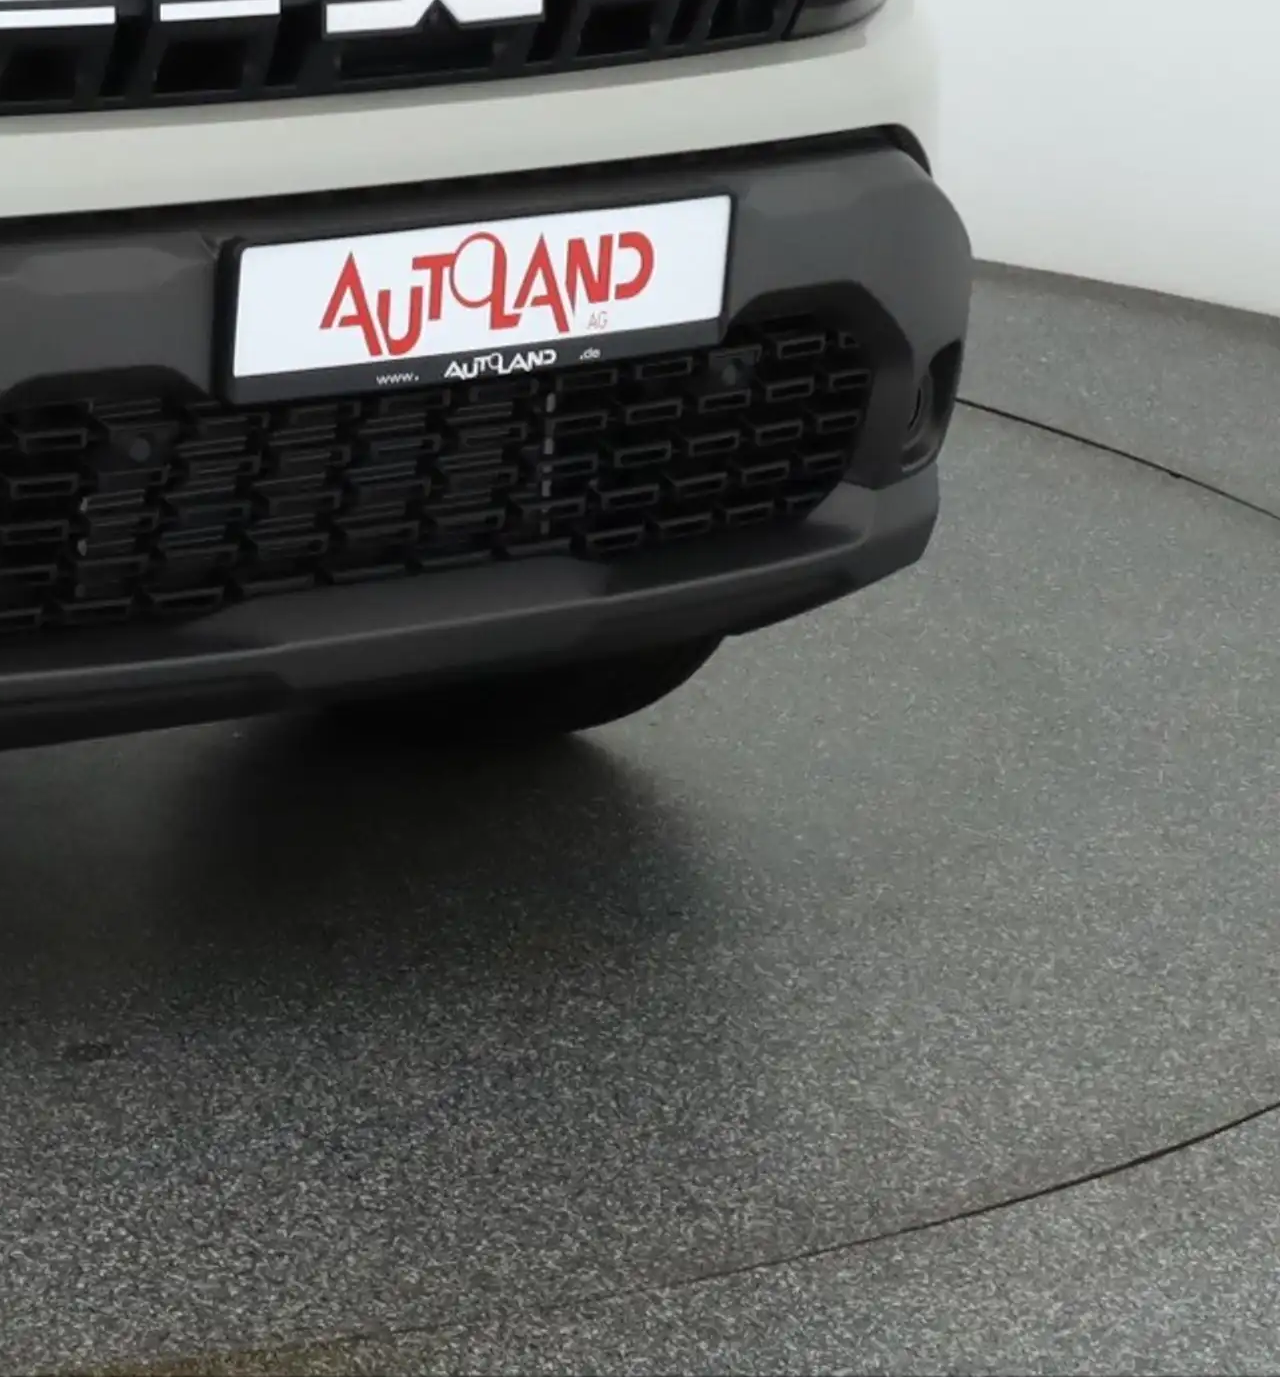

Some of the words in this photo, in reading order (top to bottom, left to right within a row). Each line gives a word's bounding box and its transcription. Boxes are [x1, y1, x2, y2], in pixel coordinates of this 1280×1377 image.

[588, 310, 608, 329] AG
[376, 371, 420, 387] www.
[579, 346, 601, 361] .de
